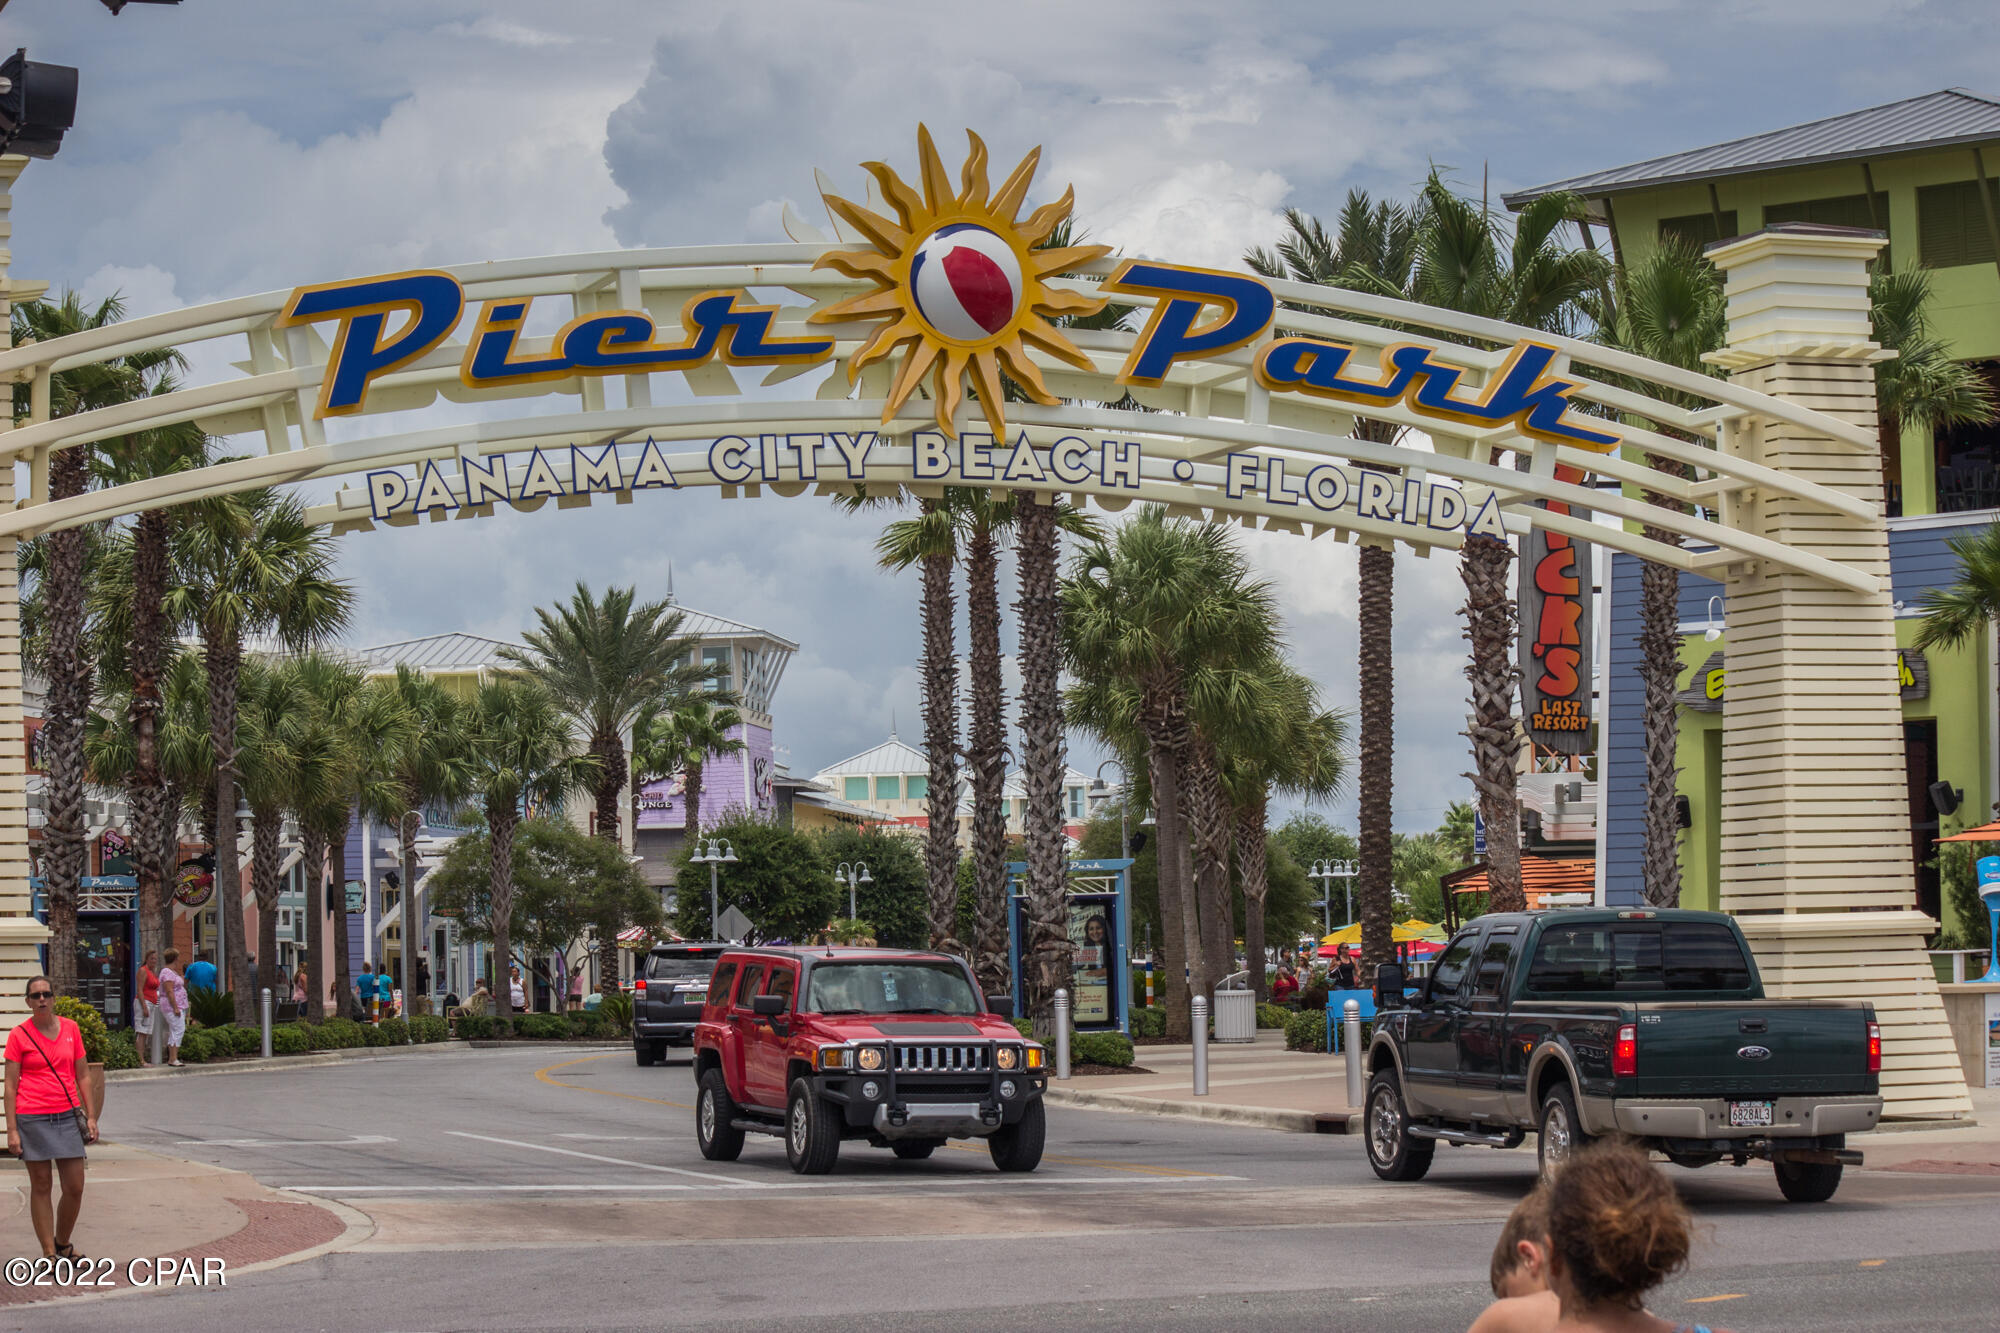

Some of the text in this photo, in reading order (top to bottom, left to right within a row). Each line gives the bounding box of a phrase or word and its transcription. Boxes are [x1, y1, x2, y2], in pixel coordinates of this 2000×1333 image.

[273, 258, 1623, 454] Pier Park
[366, 430, 1508, 543] PANAMA CITY BEACH FLORIDA
[1541, 699, 1582, 717] LAST
[1532, 714, 1589, 732] RESORT
[642, 801, 673, 809] UNGE
[1732, 1108, 1770, 1121] 6828AL3
